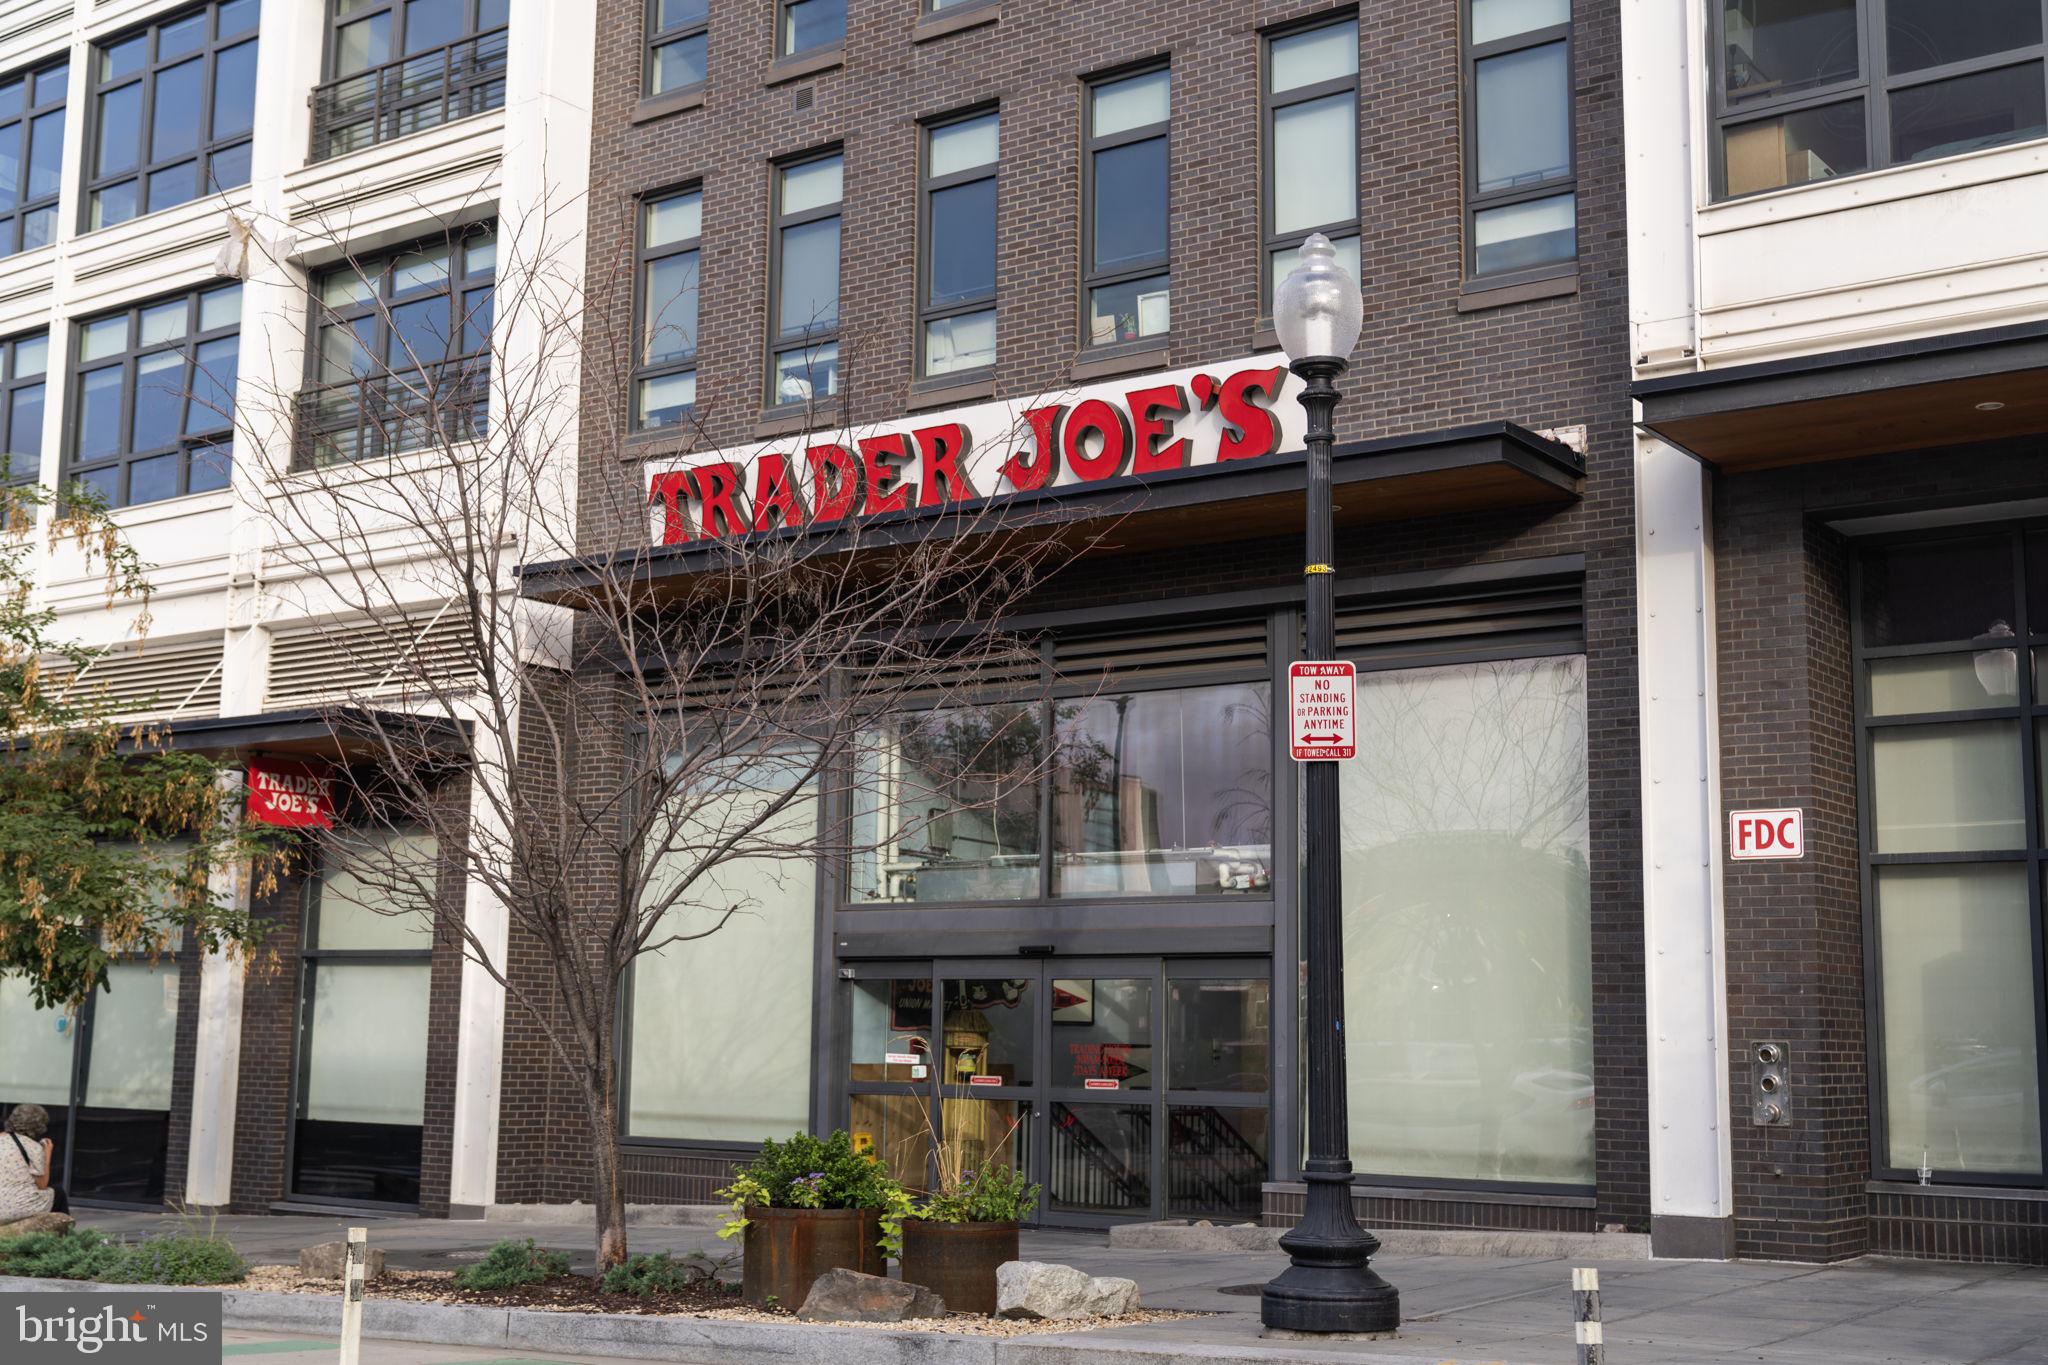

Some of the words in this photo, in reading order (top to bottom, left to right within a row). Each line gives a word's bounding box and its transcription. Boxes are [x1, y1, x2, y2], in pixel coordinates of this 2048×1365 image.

[649, 421, 975, 546] TRADER
[996, 366, 1289, 491] JOE'S
[1300, 666, 1317, 675] TOW
[1320, 666, 1345, 674] AWAY
[1315, 680, 1330, 690] NO
[1300, 693, 1346, 703] STANDING
[1297, 708, 1306, 716] OR
[1308, 707, 1349, 716] PARKING
[1304, 719, 1345, 729] ANYTIME
[1296, 749, 1302, 757] IF
[1326, 748, 1341, 757] CALL
[1343, 748, 1352, 757] 311
[257, 771, 330, 796] TRADER
[264, 792, 319, 814] JOE'S
[1738, 817, 1795, 850] FDC
